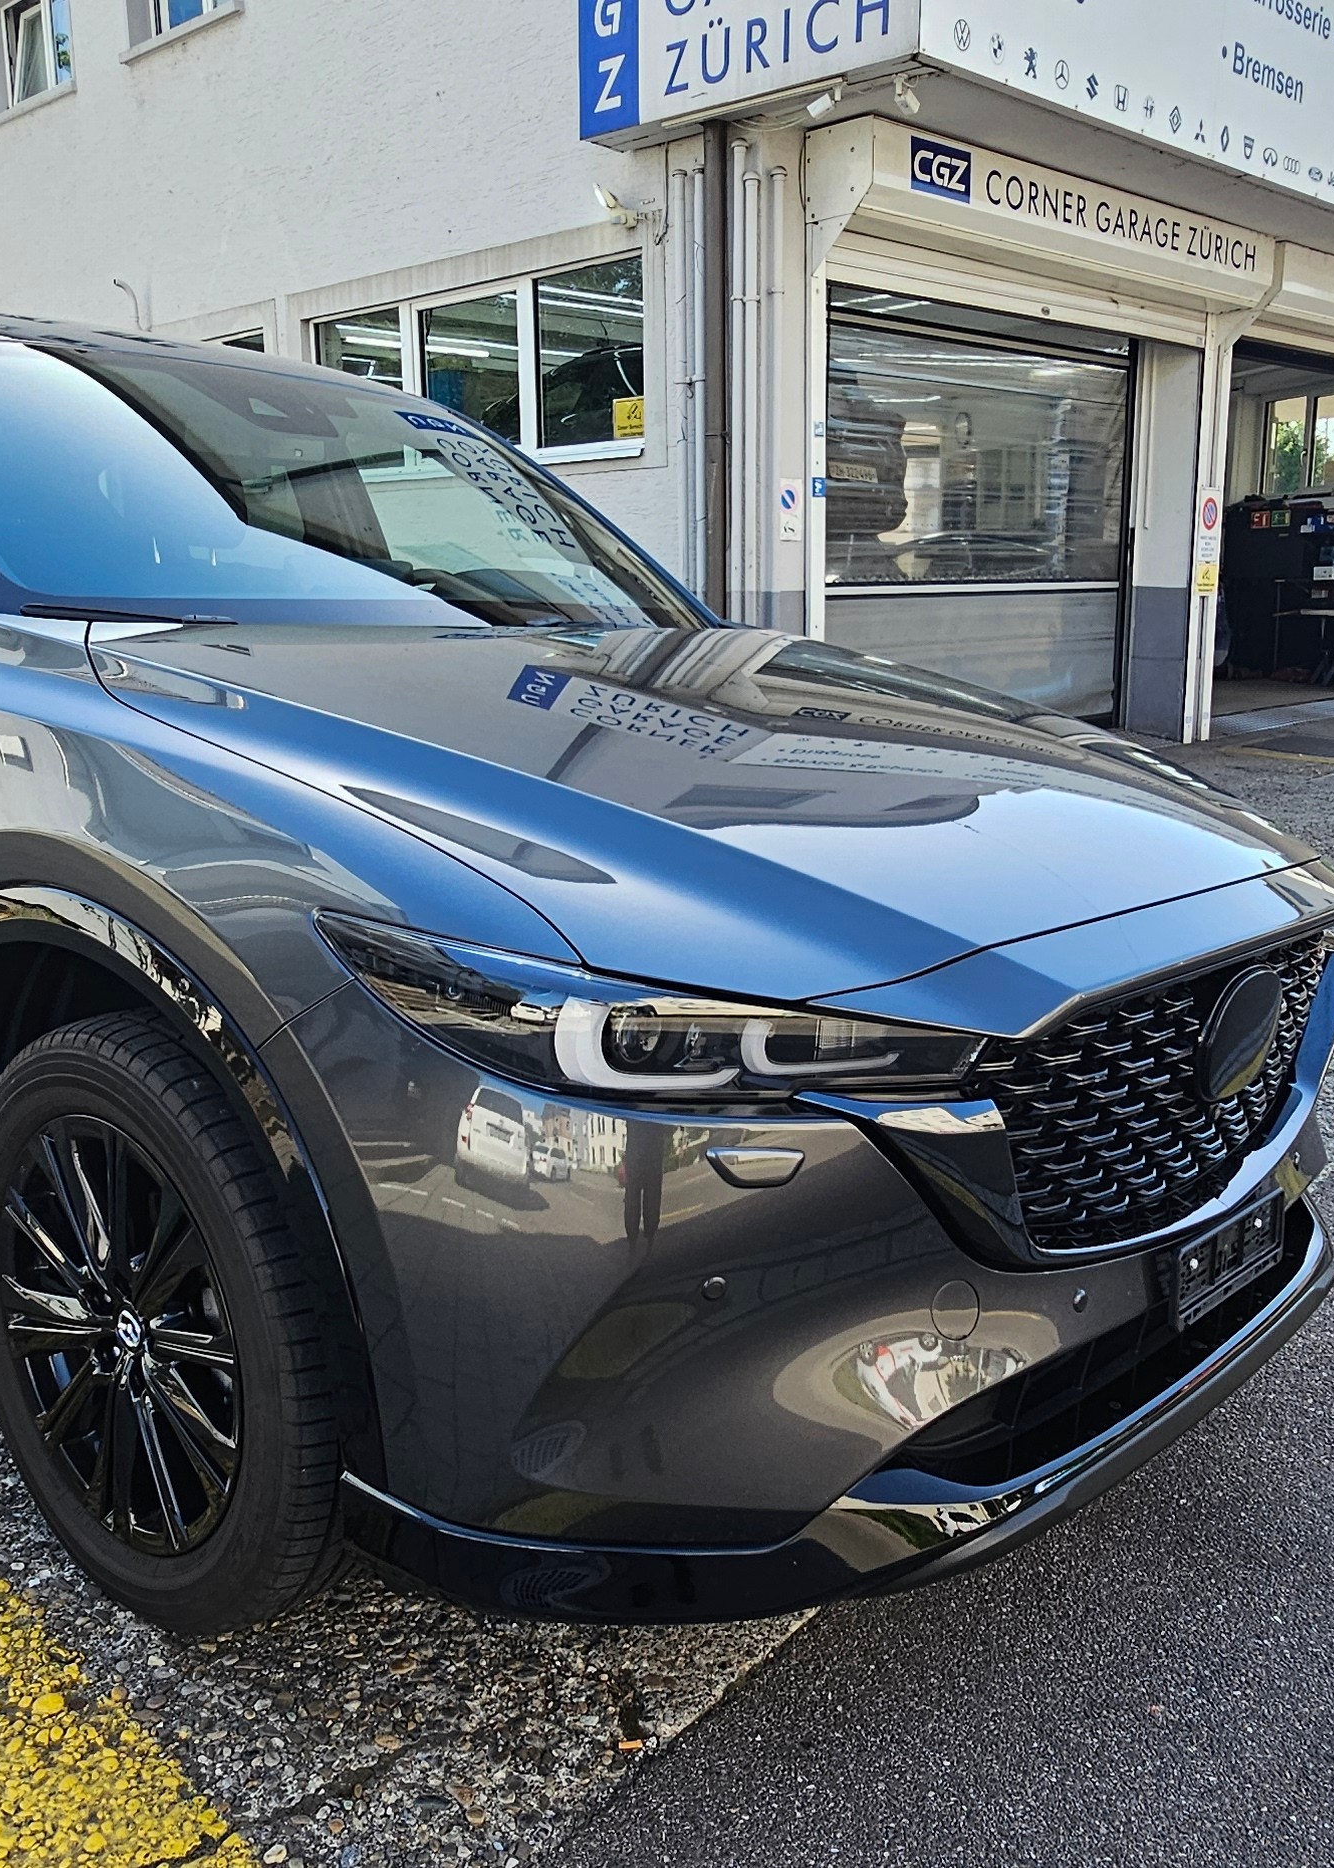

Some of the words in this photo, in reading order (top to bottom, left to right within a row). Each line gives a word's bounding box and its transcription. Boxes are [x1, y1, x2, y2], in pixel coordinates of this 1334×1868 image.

[663, 0, 890, 96] ZÜRICH
[1254, 0, 1331, 39] osserie
[1232, 41, 1304, 104] Bremsen
[913, 149, 970, 192] CGZ
[985, 169, 1087, 229] CORNER
[1095, 201, 1181, 252] GARAGE
[1186, 225, 1257, 273] ZÜRICH
